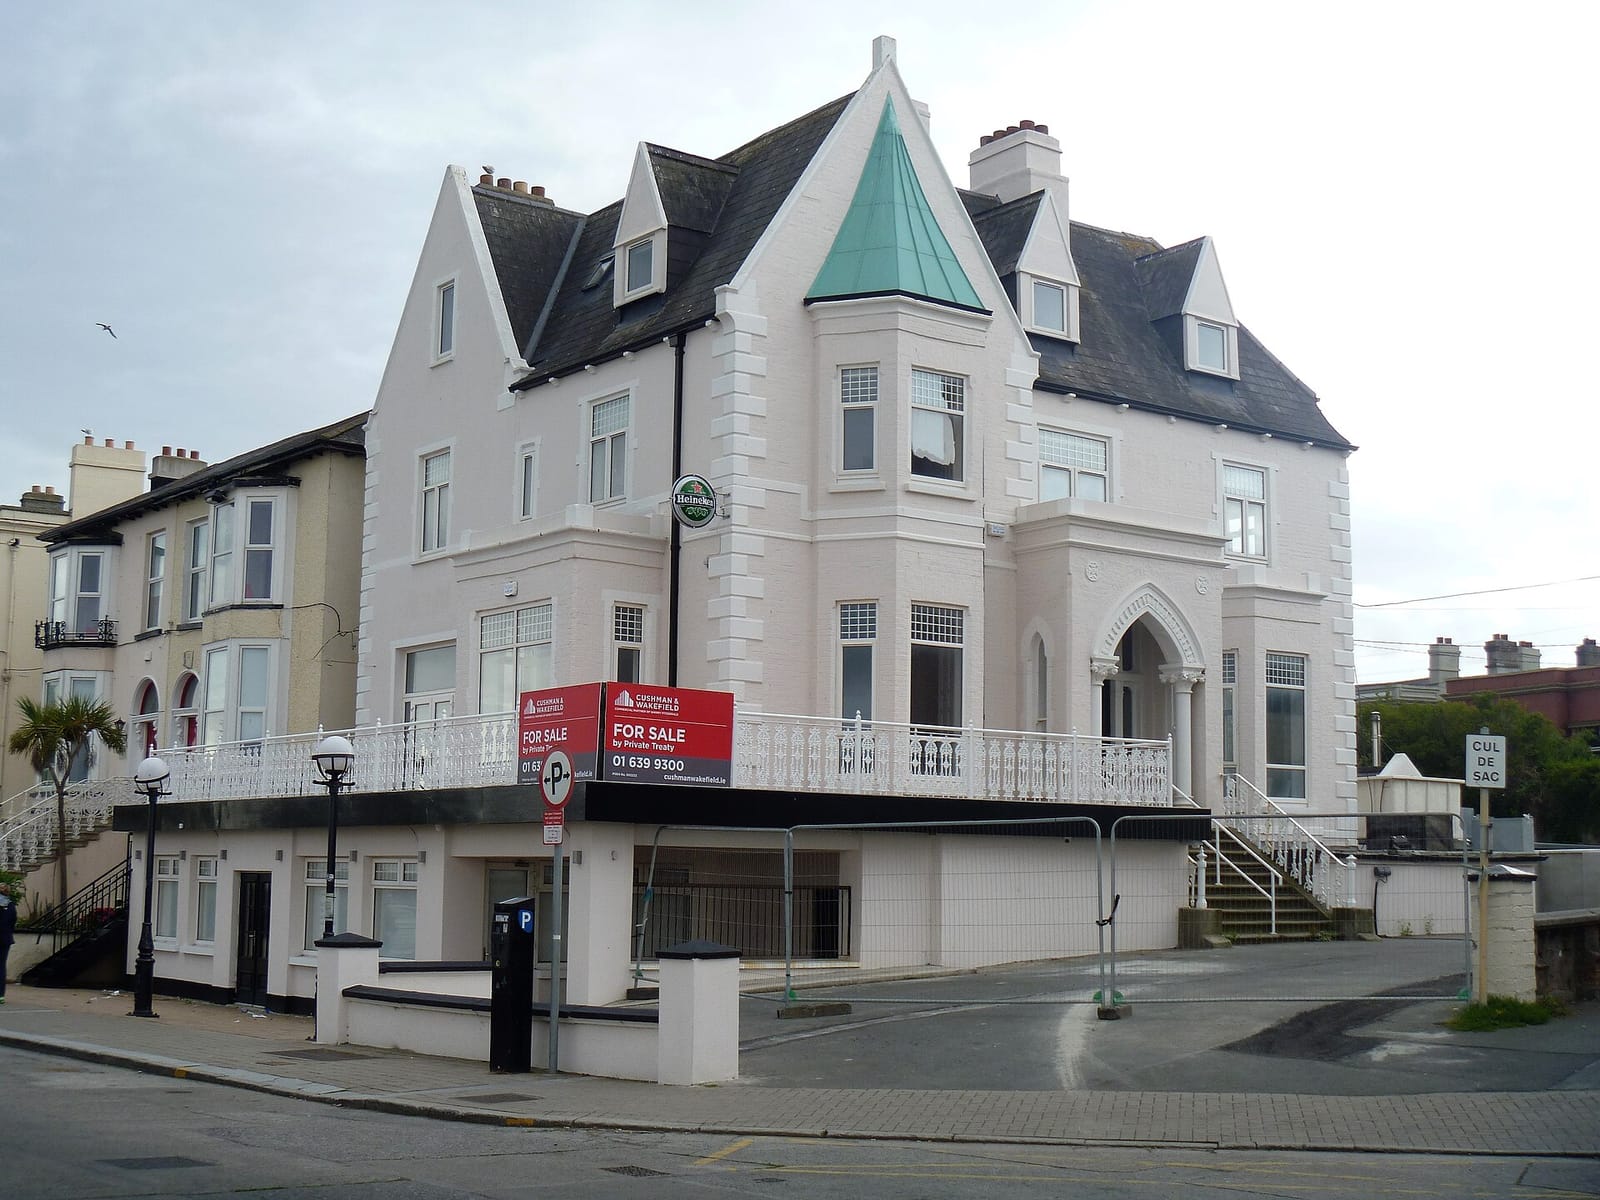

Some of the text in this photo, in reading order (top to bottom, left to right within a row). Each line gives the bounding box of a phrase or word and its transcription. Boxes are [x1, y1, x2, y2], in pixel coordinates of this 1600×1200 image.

[635, 694, 673, 704] CUSHMAN
[635, 701, 680, 712] WAKEFIELD
[523, 727, 567, 745] FOR SALE
[613, 723, 686, 742] FOR SALE
[522, 747, 529, 755] by
[529, 745, 545, 753] Private
[612, 739, 675, 752] by Private Treaty
[1472, 741, 1500, 753] CUL
[522, 761, 543, 773] 01 63
[612, 755, 685, 772] 01 639 9300
[1477, 756, 1495, 767] DE
[551, 761, 563, 796] P
[663, 773, 727, 785] cushmanwakefield.ie
[1473, 771, 1500, 782] SAC
[521, 911, 532, 929] P
